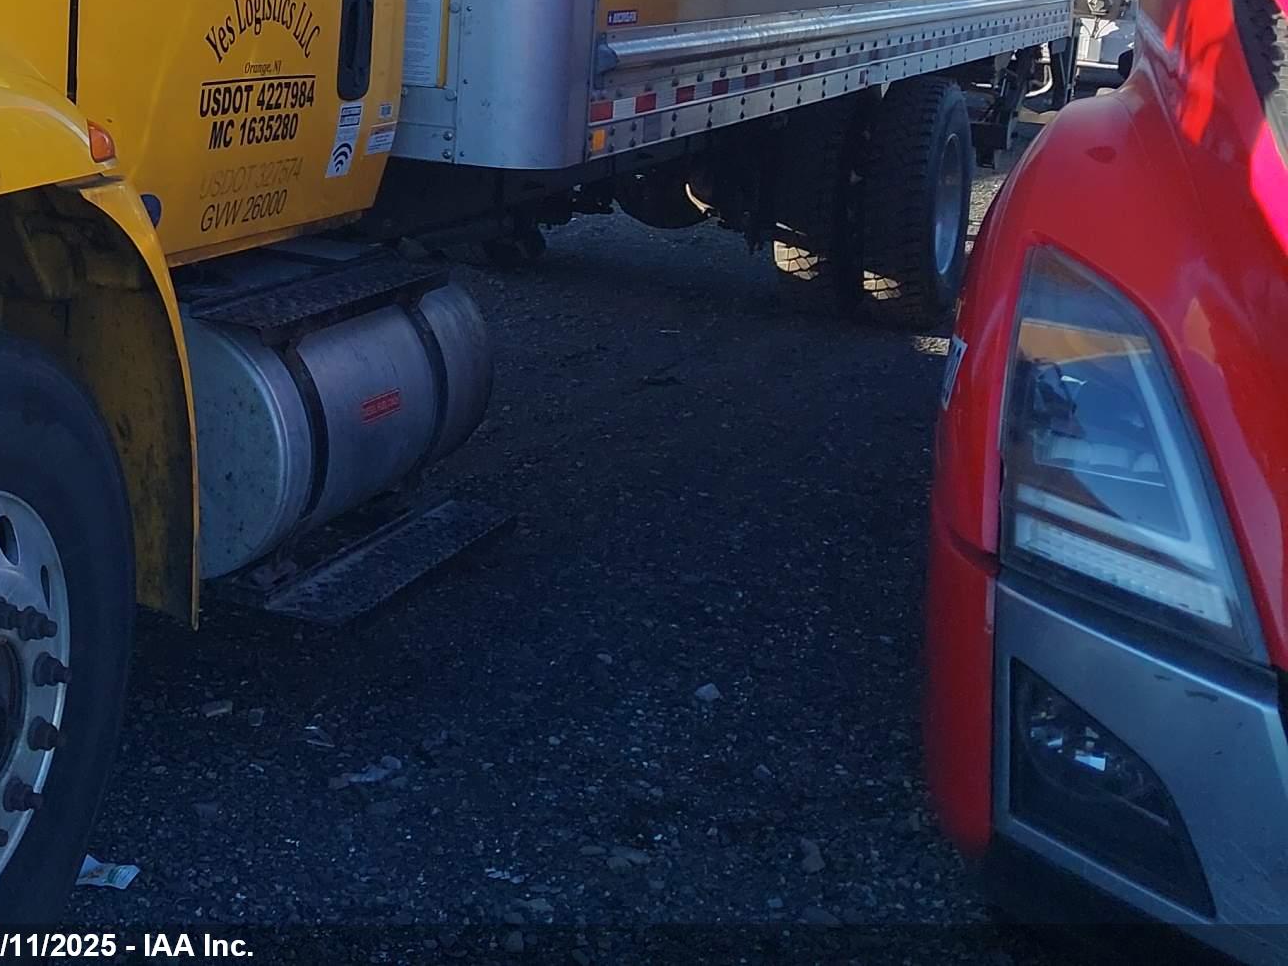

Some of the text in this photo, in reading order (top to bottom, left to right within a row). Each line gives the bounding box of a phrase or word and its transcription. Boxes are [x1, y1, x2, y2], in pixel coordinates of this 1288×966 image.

[205, 15, 237, 64] Yes
[293, 1, 321, 59] LLC
[200, 80, 316, 118] USDOT 4227984
[208, 113, 299, 150] MC 1635280
[200, 164, 257, 200] USDOT
[201, 189, 288, 232] GVW 26000
